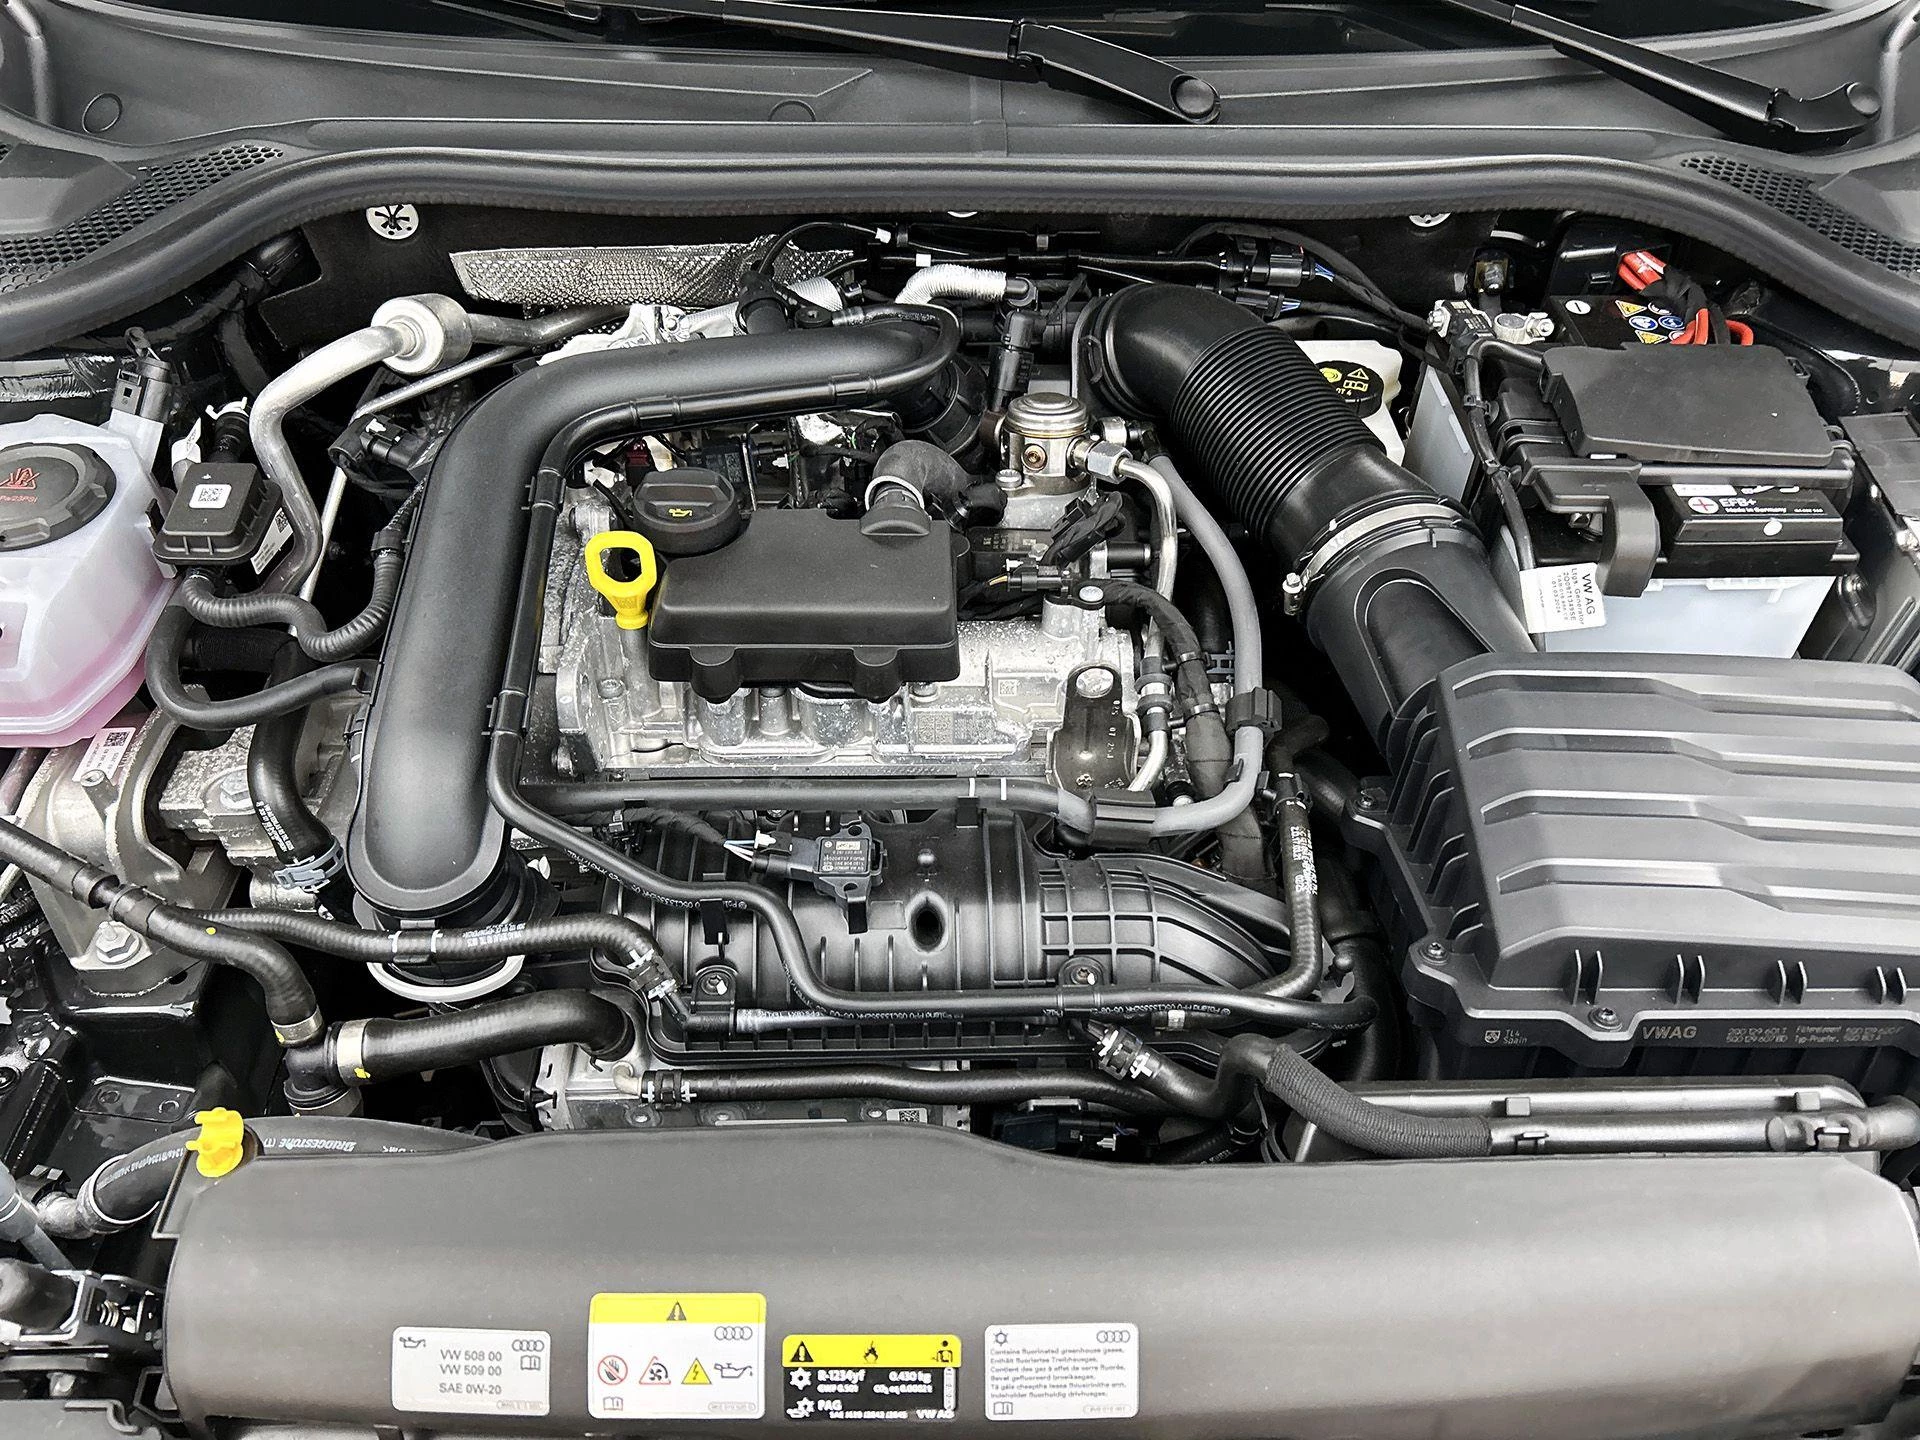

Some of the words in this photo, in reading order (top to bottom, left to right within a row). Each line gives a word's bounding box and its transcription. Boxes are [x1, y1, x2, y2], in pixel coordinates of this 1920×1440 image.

[1719, 498, 1756, 506] EFB+
[1582, 573, 1593, 593] VW
[1575, 588, 1584, 624] Generator
[1585, 598, 1596, 614] AG
[1642, 1026, 1697, 1040] VWAG
[278, 1138, 357, 1152] BRIDGESTONE
[440, 1349, 461, 1360] VW
[464, 1350, 486, 1362] 508
[488, 1351, 502, 1362] 00
[440, 1364, 461, 1374] VW
[464, 1365, 484, 1376] 509
[488, 1366, 502, 1376] 00
[439, 1382, 463, 1394] SAE
[466, 1384, 502, 1394] 0W-20
[817, 1400, 842, 1411] PAG
[916, 1409, 937, 1419] VW
